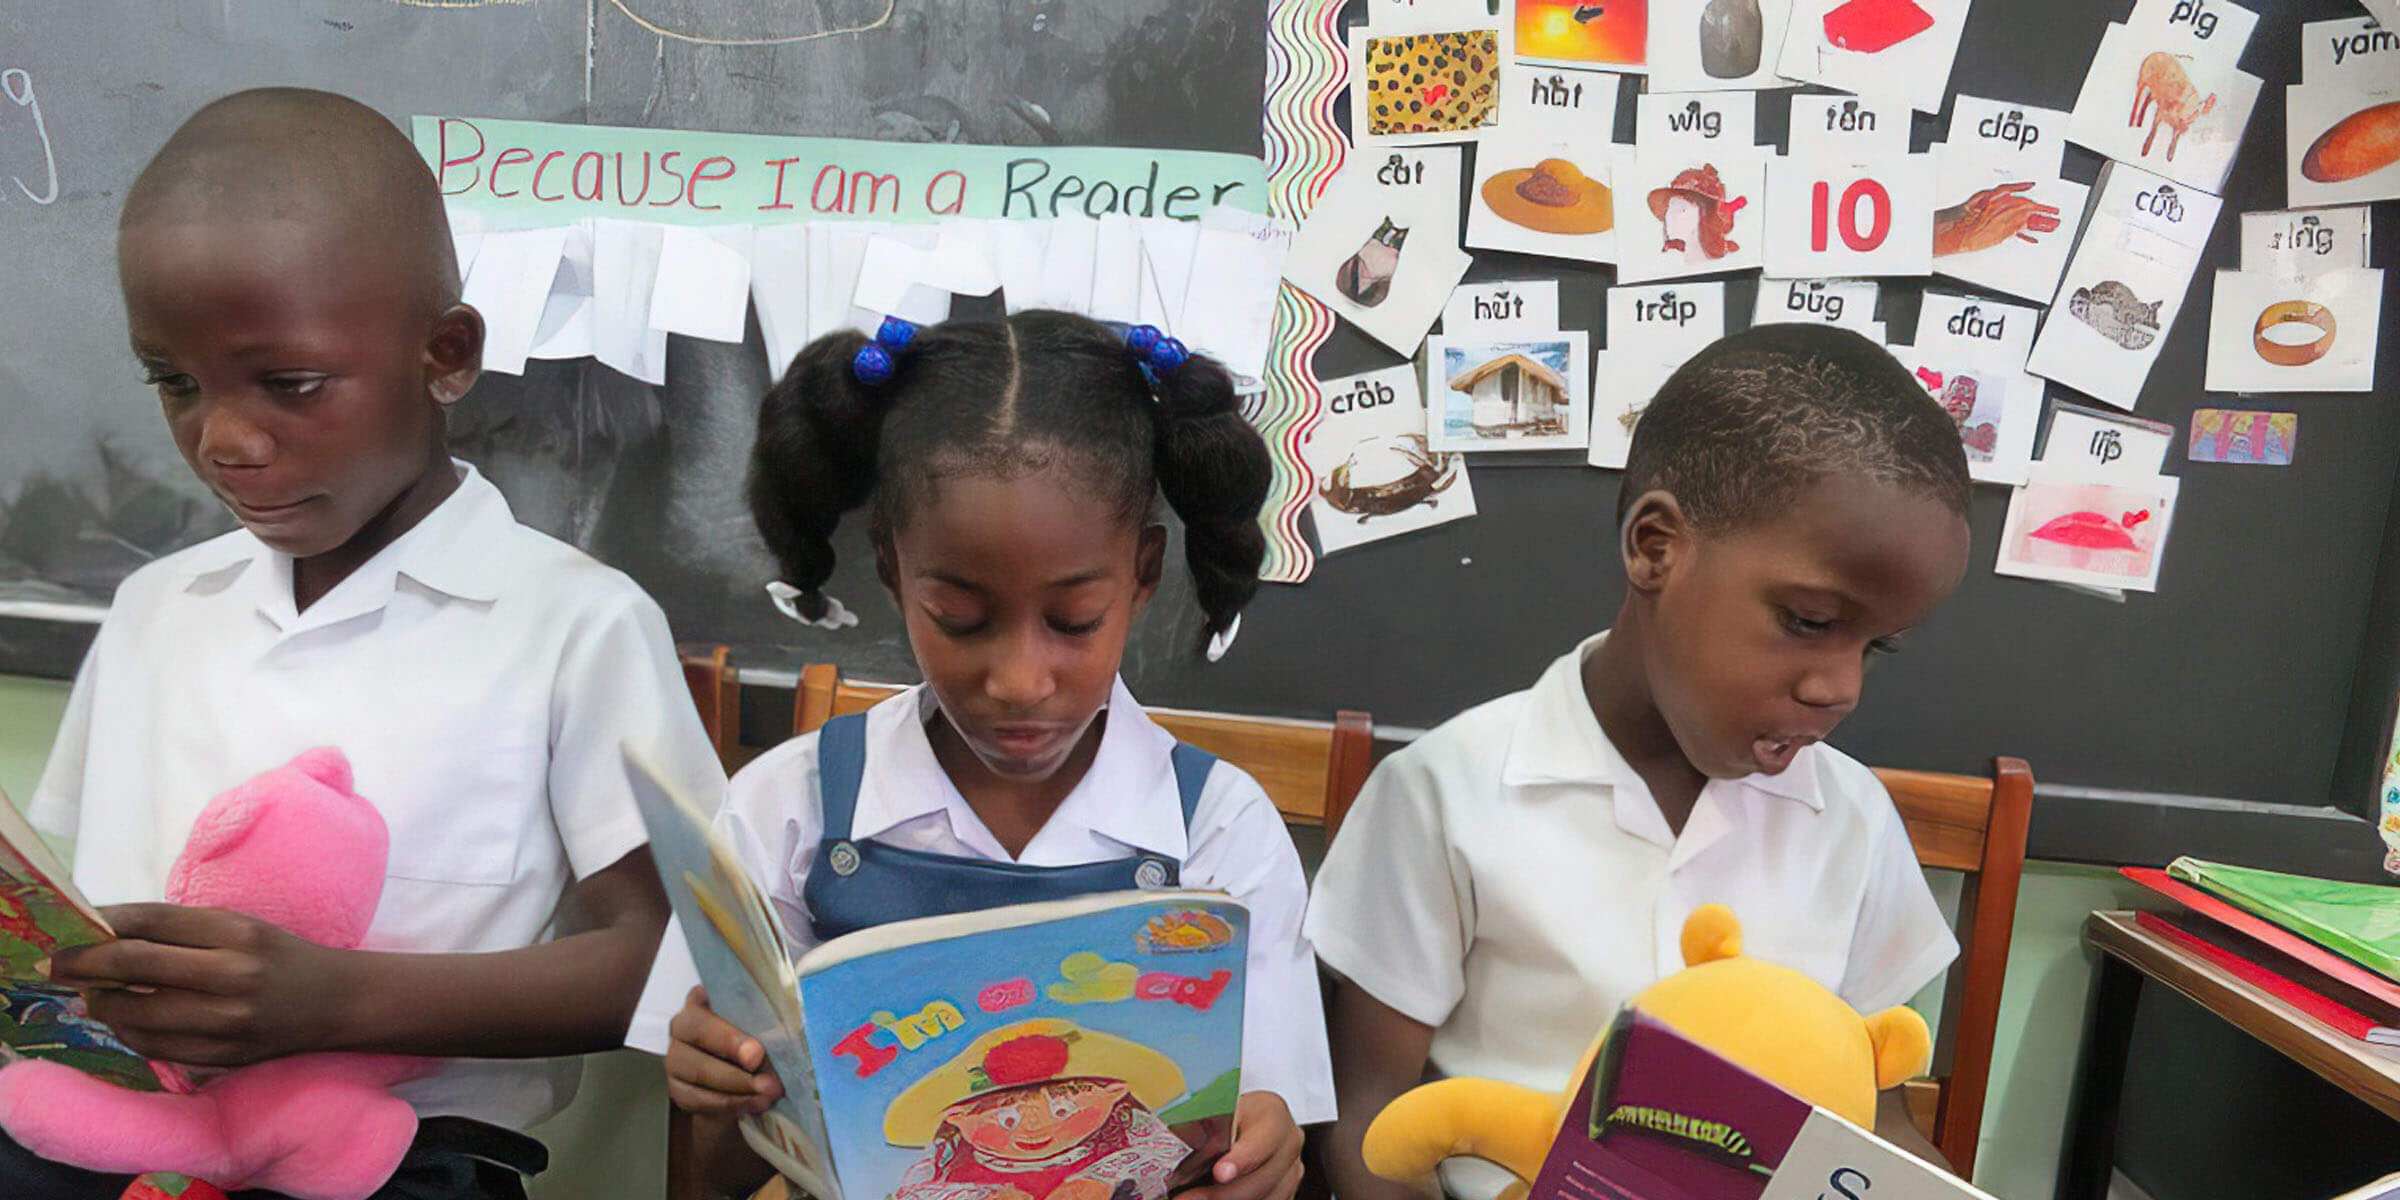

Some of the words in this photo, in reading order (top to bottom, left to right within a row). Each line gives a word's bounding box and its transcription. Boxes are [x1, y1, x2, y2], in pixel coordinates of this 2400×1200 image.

[439, 118, 737, 211] Because
[757, 156, 801, 211] I
[810, 163, 901, 215] am
[924, 169, 968, 216] a
[1001, 157, 1246, 221] Reader
[1810, 177, 1892, 253] 10
